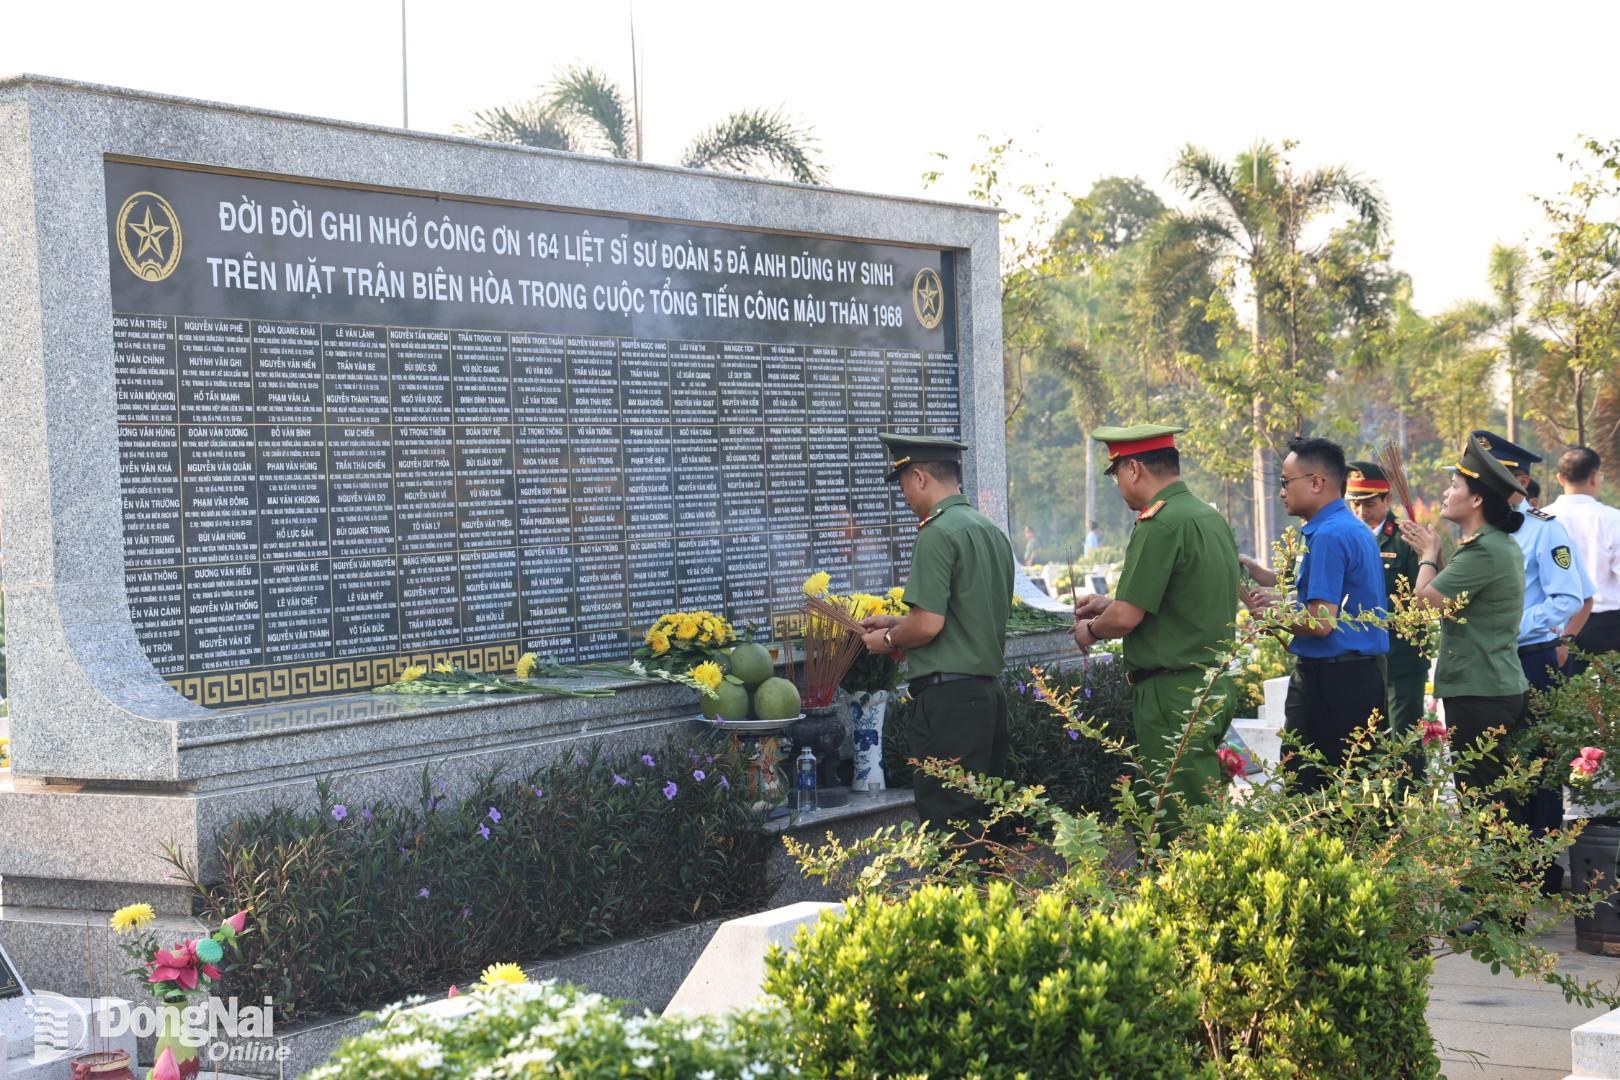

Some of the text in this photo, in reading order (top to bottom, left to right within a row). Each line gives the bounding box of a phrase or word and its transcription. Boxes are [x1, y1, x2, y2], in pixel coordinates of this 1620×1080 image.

[219, 195, 893, 286] ĐỜI ĐỜI GHI NHỚ CÔNG ƠN 164 LIỆT SĨ SƯ ĐOÀN 5 ĐÃ ANH DŨNG HY SINH
[207, 252, 902, 327] TRÊN MẶT TRẬN BIÊN HÒA TRONG CUỘC TỔNG TIẾN CÔNG MẬU THÂN 1968
[147, 317, 167, 331] TRIỆU
[185, 318, 212, 332] NGUYỄN
[258, 323, 275, 335] ĐOÀN
[277, 326, 298, 336] QUANG
[143, 353, 164, 365] CHÍNH
[190, 355, 213, 366] HUỲNH
[230, 358, 241, 368] GHI
[260, 356, 286, 368] NGUYỄN
[302, 357, 316, 369] HIẾN
[194, 389, 240, 403] HỒ TẤN MẠNH
[269, 393, 286, 404] PHẠM
[189, 425, 207, 437] ĐOÀN
[225, 427, 248, 437] DƯƠNG
[272, 424, 280, 437] ĐỖ
[188, 460, 216, 472] NGUYỄN
[233, 460, 251, 472] QUÂN
[267, 462, 284, 471] PHAN
[193, 498, 212, 509] PHẠM
[268, 496, 278, 505] MAI
[294, 495, 320, 504] KHƯƠNG
[151, 534, 174, 545] TRUNG
[198, 531, 210, 542] BÙI
[227, 529, 246, 541] HÙNG
[195, 568, 218, 579] DƯƠNG
[236, 562, 251, 576] HIẾU
[274, 562, 294, 574] HUỲNH
[310, 560, 318, 572] BÉ
[190, 600, 218, 614] NGUYỄN
[278, 596, 285, 608] LÊ
[268, 629, 293, 643] NGUYỄN
[309, 626, 329, 639] THÀNH
[200, 635, 227, 649] NGUYỄN
